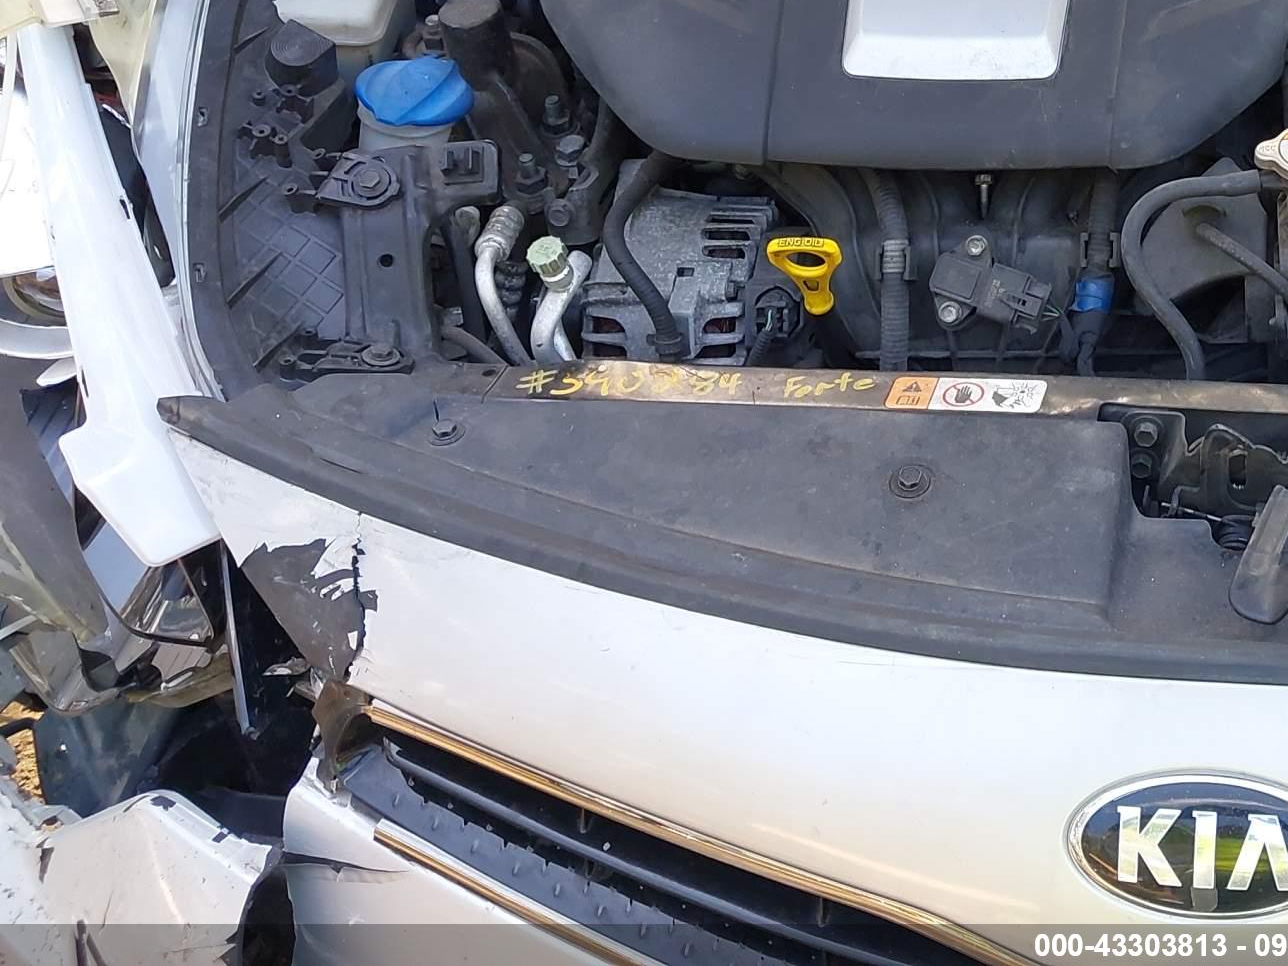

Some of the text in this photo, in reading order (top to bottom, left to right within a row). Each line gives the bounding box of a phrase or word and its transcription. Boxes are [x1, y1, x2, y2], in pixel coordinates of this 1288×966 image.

[778, 237, 824, 248] ENG OIL
[783, 372, 876, 398] Forte
